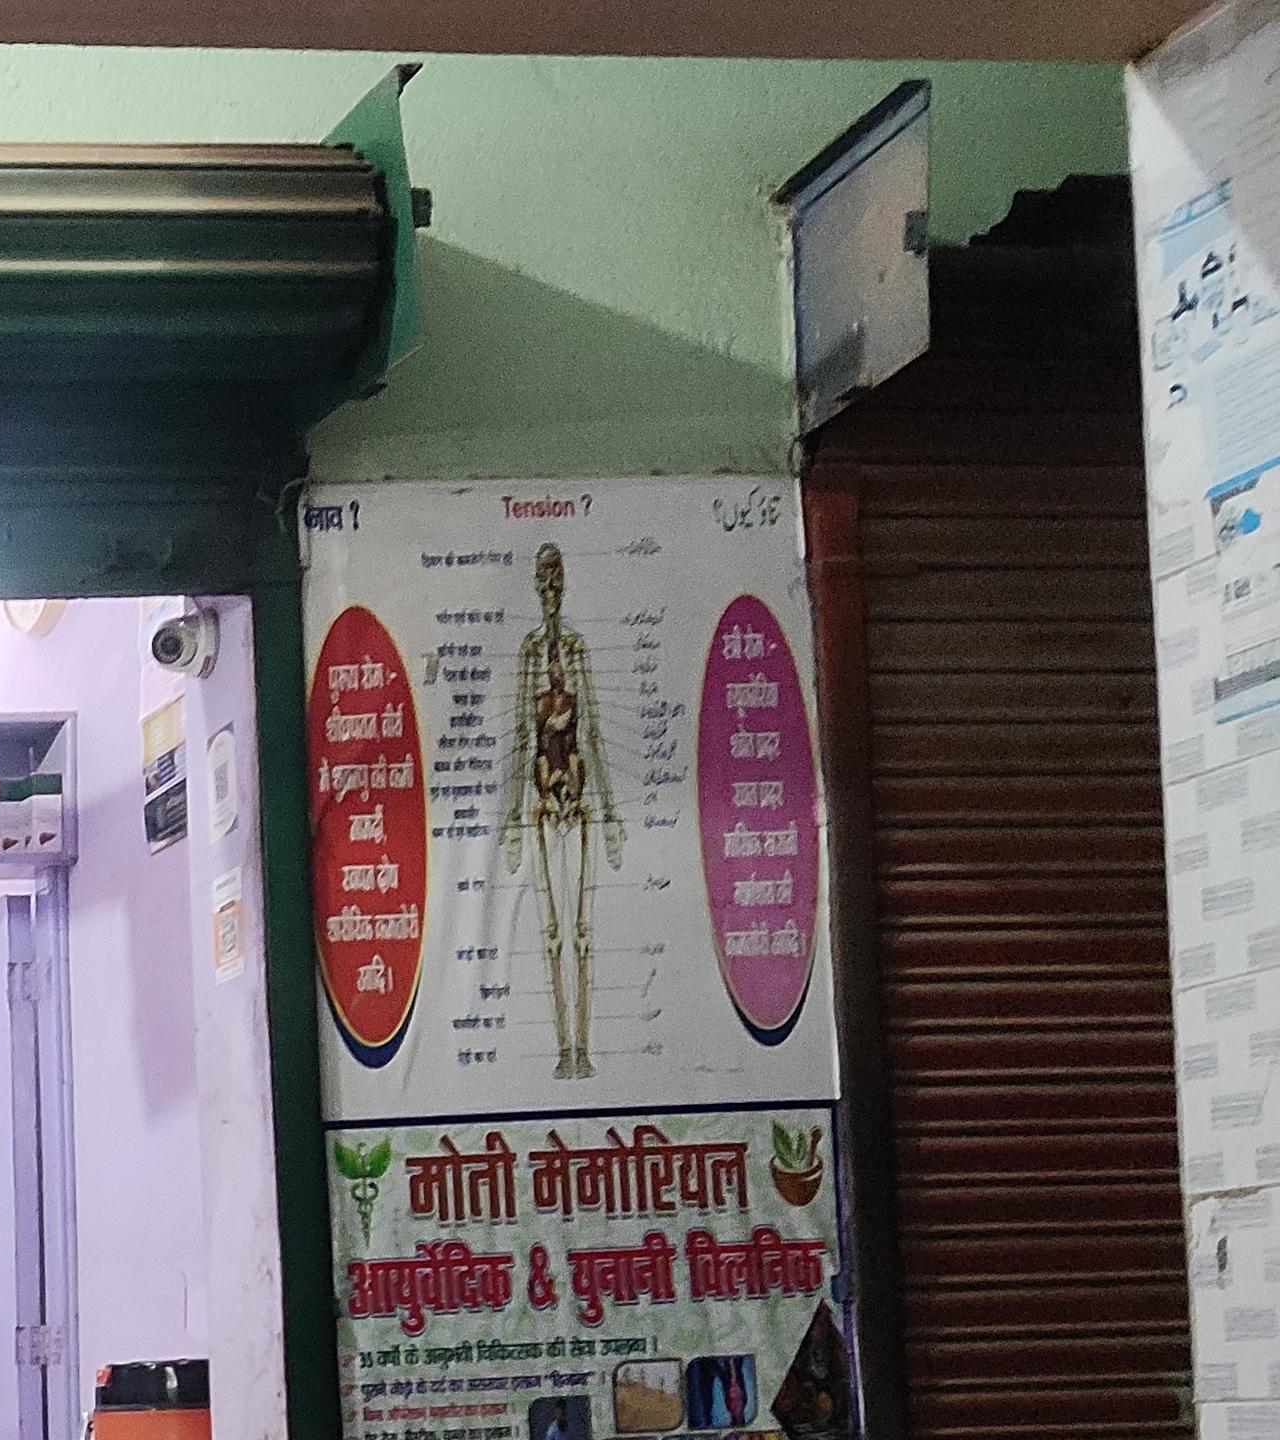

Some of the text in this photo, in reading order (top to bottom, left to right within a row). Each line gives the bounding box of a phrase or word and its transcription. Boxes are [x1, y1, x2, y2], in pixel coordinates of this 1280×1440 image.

[501, 495, 576, 520] Tension
[405, 1125, 749, 1223] मोती मेमोरियल
[348, 1224, 828, 1335] आयुर्वेदिक & युनानी क्लिनिक
